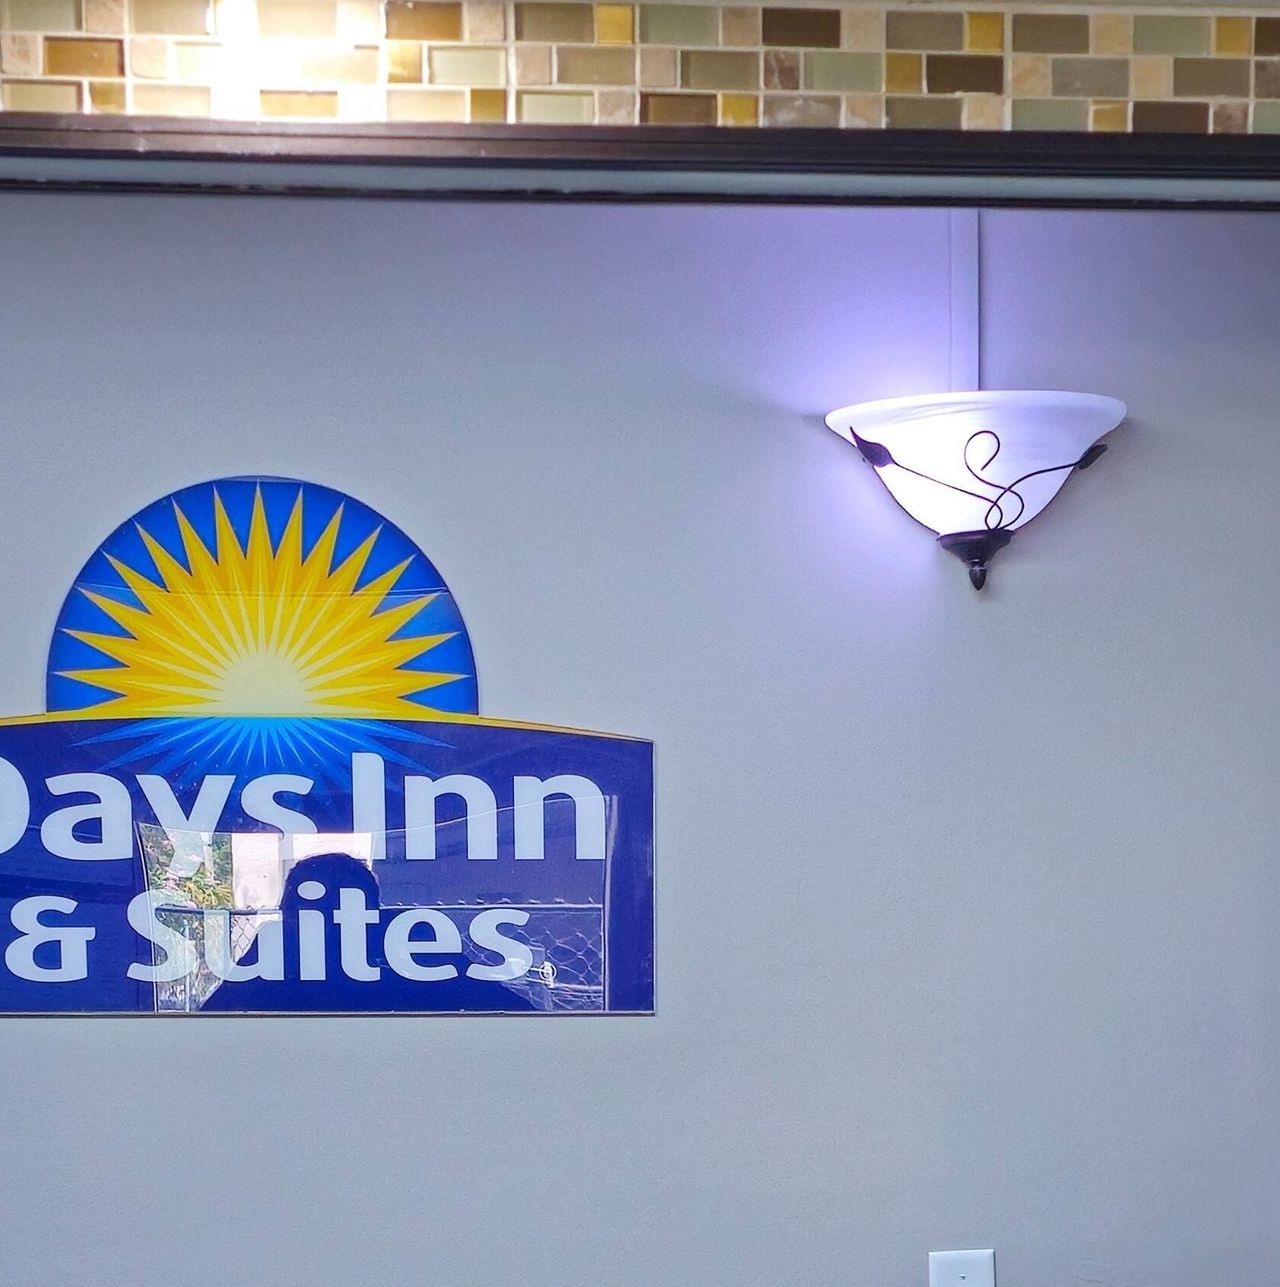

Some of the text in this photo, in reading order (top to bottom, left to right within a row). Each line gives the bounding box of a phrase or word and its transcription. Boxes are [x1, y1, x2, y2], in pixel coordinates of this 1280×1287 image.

[351, 750, 605, 861] Inn
[4, 881, 533, 982] & Suites
